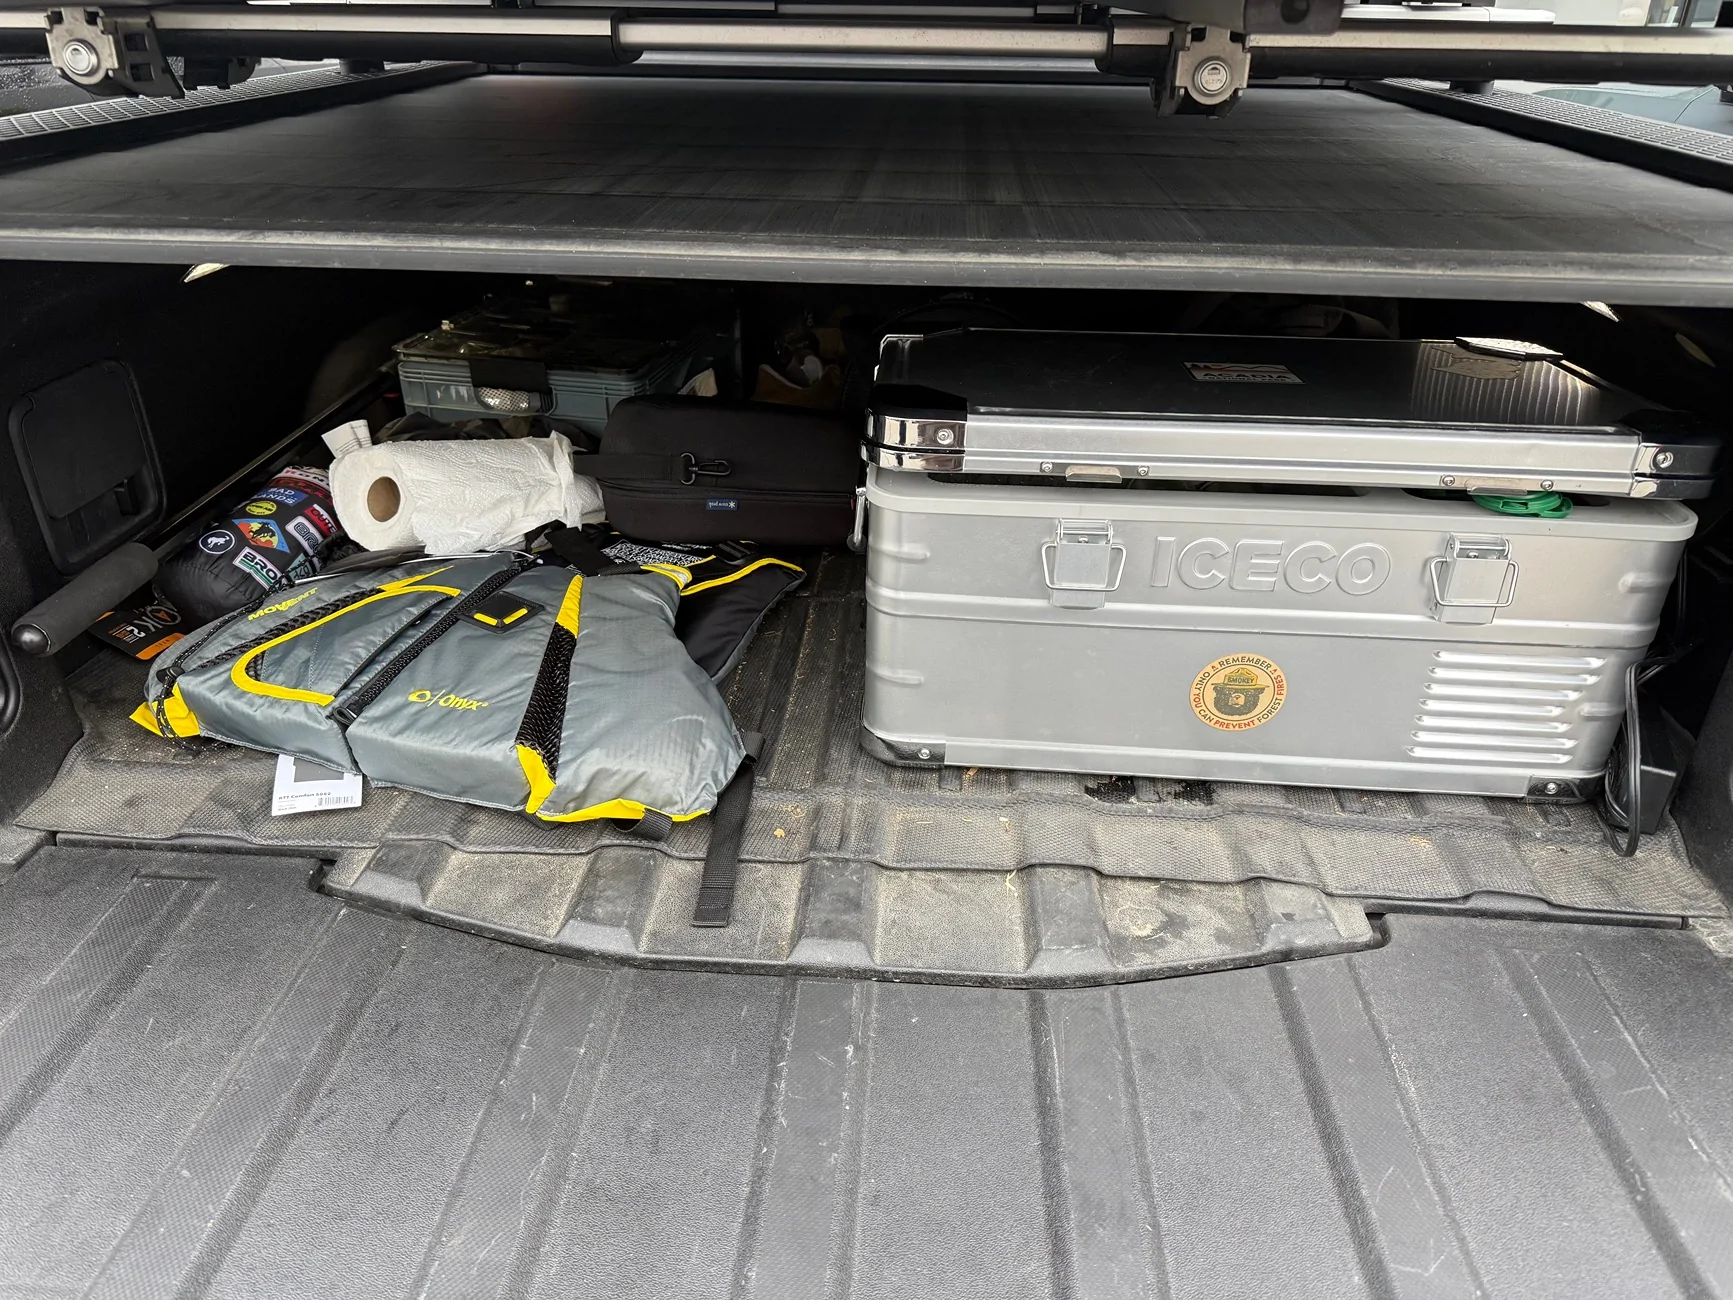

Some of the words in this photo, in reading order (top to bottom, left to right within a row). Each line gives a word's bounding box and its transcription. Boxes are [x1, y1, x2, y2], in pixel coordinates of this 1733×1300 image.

[268, 487, 295, 496] BAD
[310, 509, 337, 533] OUTE
[242, 551, 280, 580] BRO
[1150, 537, 1391, 596] ICECO
[1218, 656, 1272, 670] REMEMBER
[1195, 671, 1210, 690] ONLY
[1273, 674, 1284, 695] FIRES
[1193, 692, 1202, 708] YOU
[1256, 697, 1282, 722] FOREST
[1198, 709, 1214, 722] CAN
[1213, 719, 1255, 729] PREVENT
